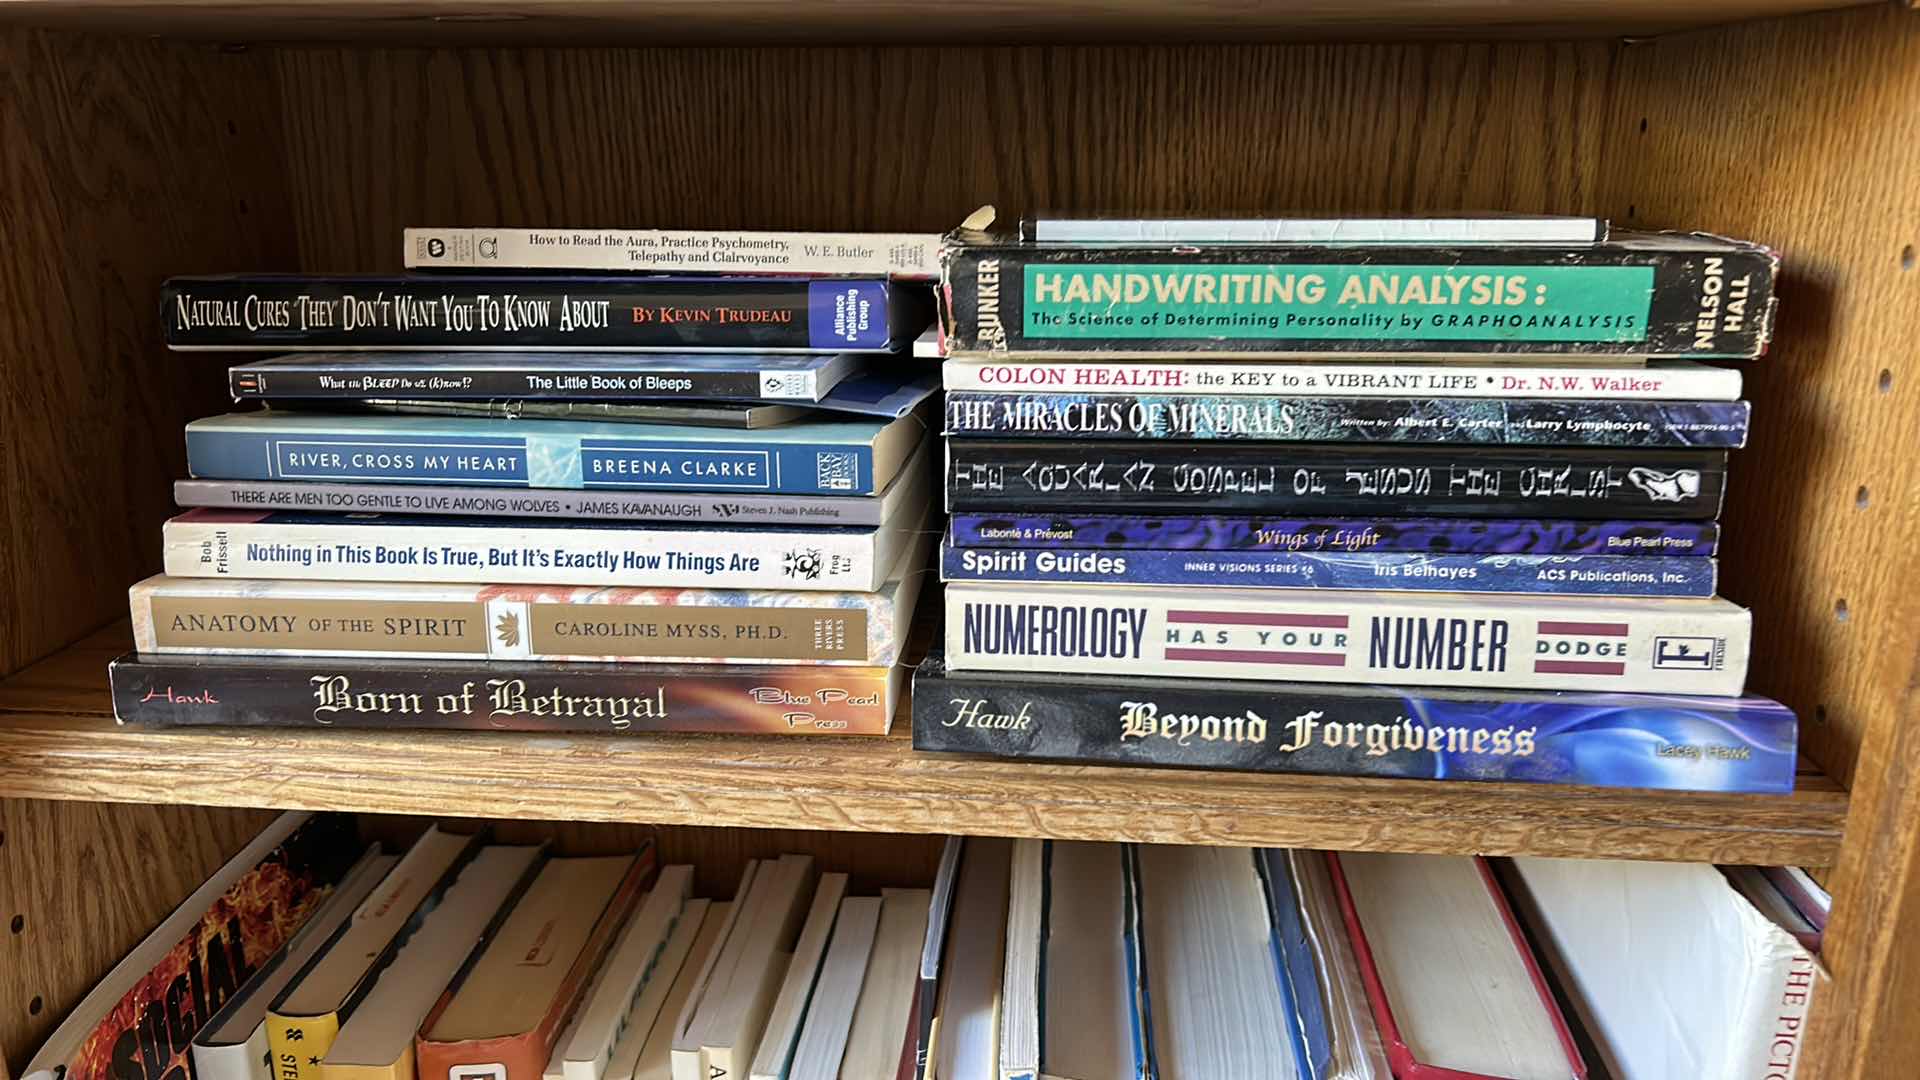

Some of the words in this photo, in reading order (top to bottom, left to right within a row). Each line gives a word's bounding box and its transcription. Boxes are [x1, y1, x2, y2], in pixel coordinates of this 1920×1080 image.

[530, 234, 557, 246] How
[559, 236, 570, 246] to
[573, 235, 601, 246] Read
[605, 236, 623, 247] the
[626, 236, 658, 248] Aura,
[661, 236, 708, 248] Practice
[712, 236, 790, 251] Psychometry,
[804, 246, 820, 257] W.
[838, 246, 874, 258] Butler
[630, 251, 685, 264] Telepathy
[688, 252, 710, 263] and
[712, 252, 790, 266] Clairvoyance
[1035, 273, 1326, 305] HANDWRITING
[176, 294, 241, 330] NATURAL
[244, 294, 290, 331] CURES
[343, 292, 390, 330] DON'T
[395, 294, 438, 331] WANT
[442, 294, 474, 332] YOU
[476, 295, 500, 331] TO
[504, 294, 551, 332] KNOW
[559, 294, 610, 332] ABOUT
[1694, 257, 1724, 350] NELSON
[1723, 274, 1751, 332] HALL
[632, 307, 655, 325] BY
[660, 307, 711, 324] KEVIN
[716, 307, 792, 324] TRUDEAU
[834, 294, 846, 336] Alliance
[846, 288, 859, 342] Publishing
[858, 300, 870, 331] Group
[1032, 312, 1062, 326] The
[1068, 312, 1134, 326] Science
[1140, 312, 1160, 326] of
[1165, 313, 1281, 330] Determining
[1286, 314, 1394, 330] Personality
[1400, 314, 1422, 330] by
[1432, 314, 1636, 329] GRAPHOANALYSIS
[320, 376, 345, 389] What
[526, 376, 554, 390] The
[556, 376, 588, 390] Little
[591, 376, 626, 390] Book
[629, 376, 643, 391] of
[646, 376, 692, 392] Bleeps
[978, 367, 1064, 385] COLON
[1074, 368, 1190, 387] HEALTH:
[1196, 372, 1225, 386] the
[1232, 372, 1276, 386] KEY
[1282, 374, 1300, 387] to
[1306, 377, 1316, 387] a
[1326, 374, 1421, 388] VIBRANT
[1428, 375, 1478, 390] LIFE
[1500, 376, 1530, 391] Dr.
[1538, 377, 1584, 391] N.W.
[1590, 377, 1662, 392] Walker
[949, 401, 996, 432] THE
[1002, 402, 1122, 432] MIRACLES
[1128, 403, 1166, 432] OF
[1167, 404, 1295, 434] MINERALS
[1340, 418, 1375, 427] Written
[1394, 418, 1438, 428] Albert
[1441, 418, 1454, 428] E.
[1459, 418, 1502, 428] Carter
[1526, 418, 1563, 431] Larry
[1566, 420, 1651, 432] Lymphocyte
[289, 452, 348, 470] RIVER,
[352, 454, 414, 469] CROSS
[424, 456, 450, 470] MY
[457, 456, 518, 472] HEART
[593, 460, 672, 475] BREENA
[681, 461, 758, 477] CLARKE
[954, 459, 1003, 491] THE
[1021, 460, 1154, 492] AQUARIAN
[1172, 464, 1275, 494] GOSPEL
[1293, 468, 1326, 494] OF
[1345, 466, 1431, 496] JESUS
[1448, 464, 1500, 496] THE
[1519, 464, 1622, 498] CHRIST
[232, 490, 266, 504] THERE
[268, 491, 293, 504] ARE
[295, 492, 323, 505] MEN
[326, 492, 354, 506] TOO
[356, 493, 401, 508] GENTLE
[404, 495, 422, 509] TO
[425, 496, 450, 510] LIVE
[452, 497, 507, 512] AMONG
[510, 498, 560, 513] WOLVES
[576, 501, 620, 515] JAMES
[622, 502, 702, 517] KAVANAUGH
[778, 507, 798, 516] Nash
[800, 507, 840, 518] Publishing
[1256, 528, 1308, 550] Wings
[1330, 528, 1382, 550] Light
[1608, 536, 1632, 548] Blue
[1634, 537, 1662, 548] Pearl
[1664, 538, 1694, 548] Press
[200, 541, 212, 562] Bob
[216, 532, 228, 573] Frissell
[246, 544, 312, 566] Nothing
[316, 544, 332, 562] in
[336, 546, 371, 564] This
[376, 546, 418, 564] Book
[423, 547, 438, 565] Is
[442, 548, 484, 569] True,
[488, 548, 518, 567] But
[522, 548, 550, 568] It's
[554, 550, 618, 574] Exactly
[622, 550, 661, 570] How
[666, 552, 725, 574] Things
[729, 552, 760, 572] Are
[962, 550, 1026, 574] Spirit
[1035, 552, 1126, 574] Guides
[830, 555, 840, 575] Frog
[1184, 562, 1216, 572] INNER
[1218, 563, 1261, 572] VISIONS
[1264, 564, 1298, 573] SERIES
[1374, 564, 1398, 576] Iris
[1403, 564, 1477, 578] Belhayes
[1537, 568, 1566, 581] ACS
[1570, 569, 1659, 584] Publications,
[1663, 571, 1688, 584] Inc.
[171, 614, 297, 633] ANATOMY
[308, 618, 331, 632] OF
[336, 618, 374, 633] THE
[384, 618, 466, 636] SPIRIT
[554, 622, 658, 638] CAROLINE
[666, 624, 728, 640] MYSS,
[735, 624, 788, 640] PH.D.
[814, 619, 822, 649] THREE
[836, 619, 844, 650] PRESS
[964, 602, 1148, 660] NUMEROLOGY
[1166, 629, 1230, 644] HAS
[1258, 630, 1348, 648] YOUR
[1368, 616, 1509, 672] NUMBER
[1536, 640, 1628, 656] DODGE
[141, 686, 219, 705] Hawk
[310, 675, 422, 724] Born
[435, 681, 476, 716] of
[486, 678, 669, 730] Betrayal
[748, 686, 810, 706] Blue
[815, 688, 879, 706] Pearl
[784, 712, 848, 730] Press
[942, 698, 1032, 731] Hawk
[1120, 701, 1268, 746] Beyond
[1279, 712, 1537, 757] Forgiveness
[1656, 743, 1701, 760] Lacey
[1705, 745, 1752, 761] Hawk
[1782, 956, 1814, 1006] THE
[280, 1054, 298, 1080] STE
